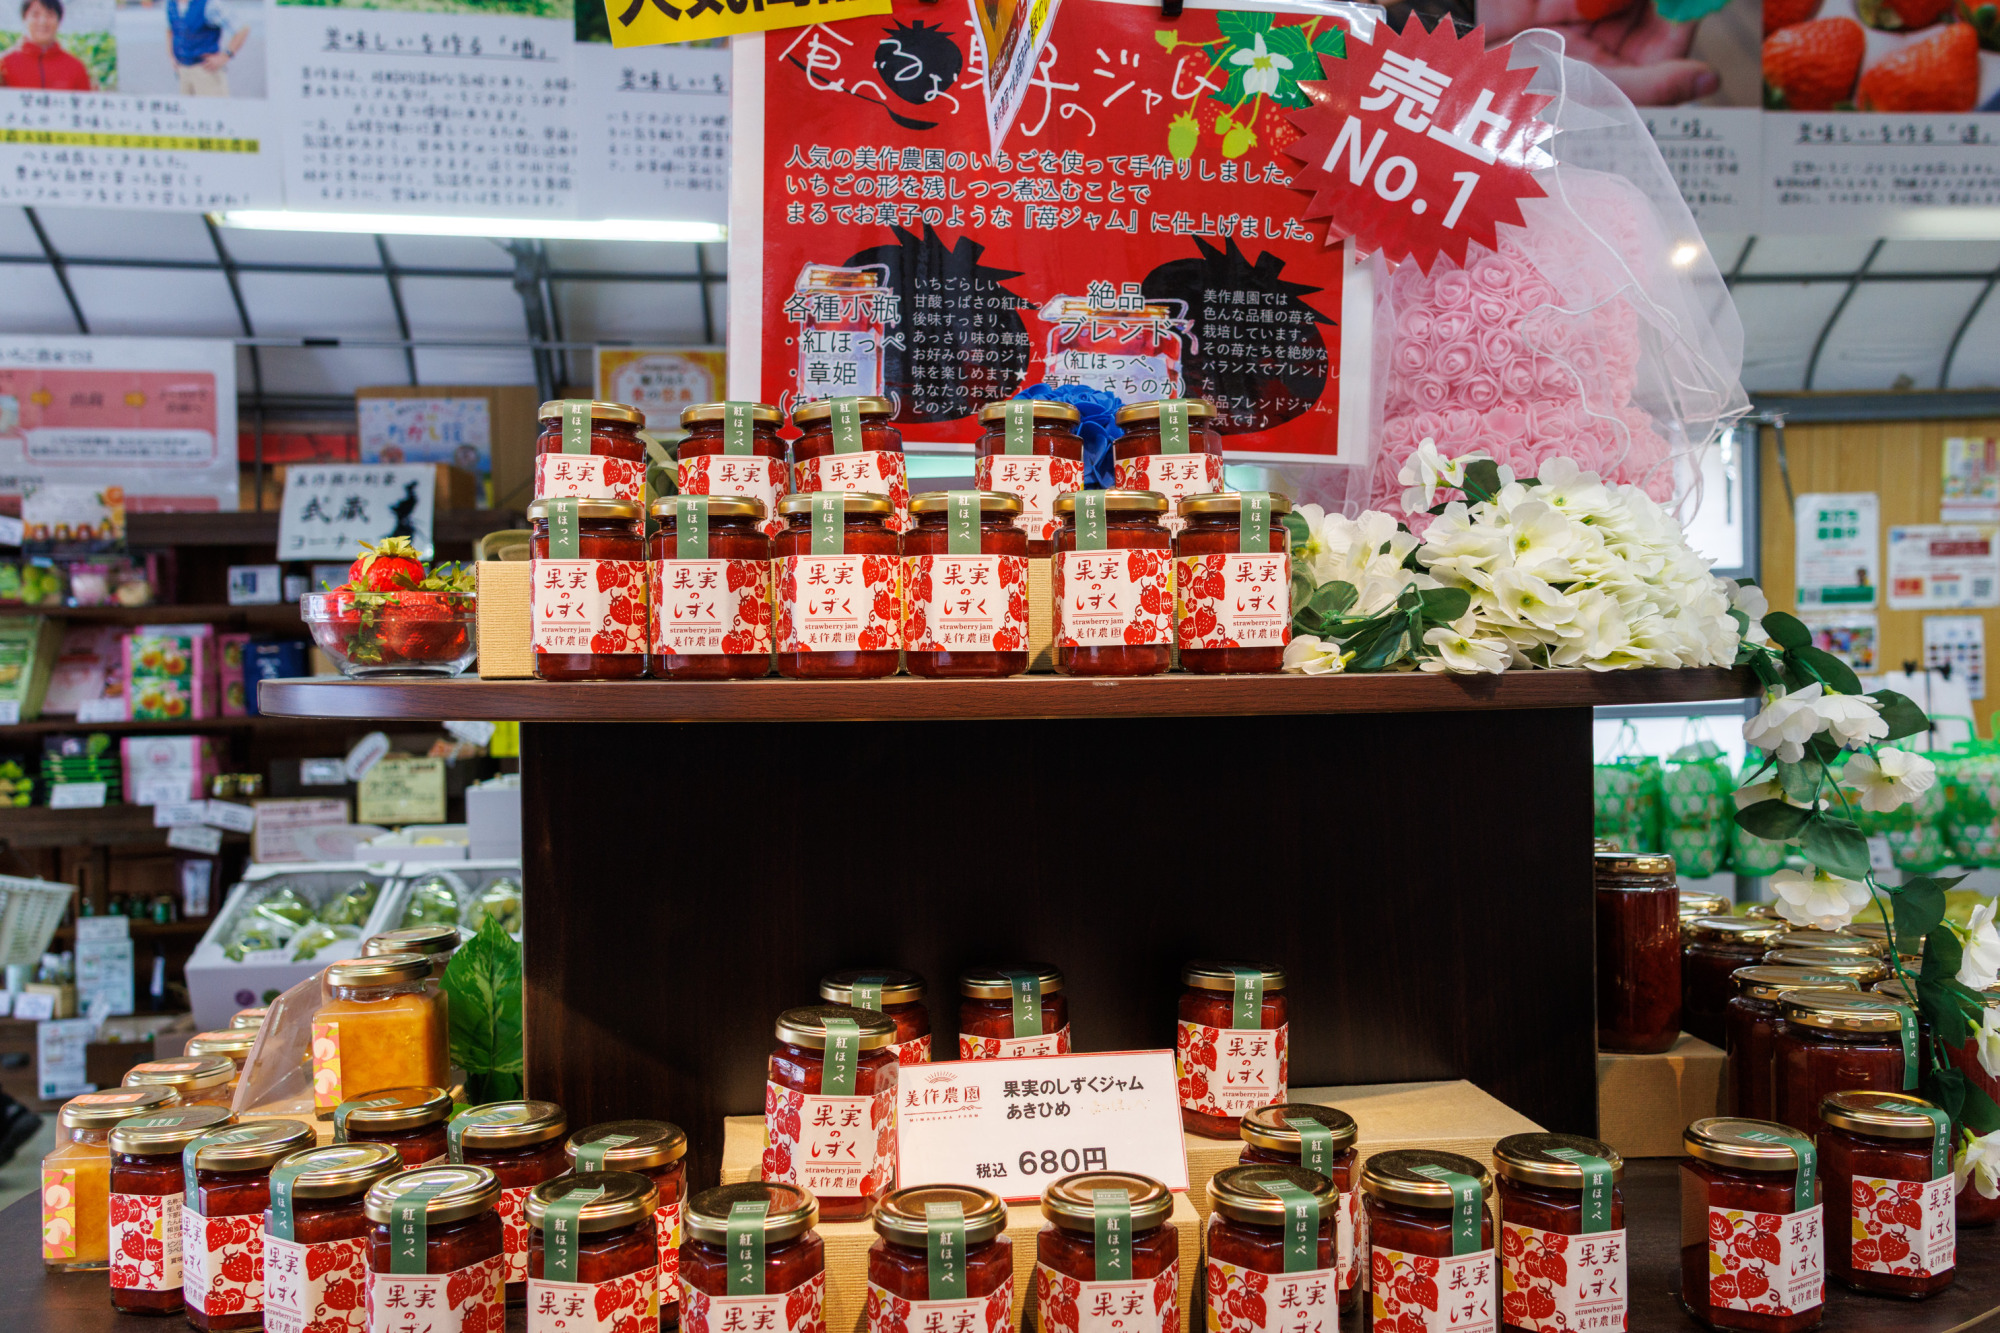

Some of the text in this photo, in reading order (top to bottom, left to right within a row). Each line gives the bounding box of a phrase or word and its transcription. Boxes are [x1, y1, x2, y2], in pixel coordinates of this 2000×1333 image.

[1360, 49, 1512, 166] 売上
[785, 144, 1294, 187] 人気の美作農園のいちごを使って手作りしました。
[1321, 114, 1481, 230] No.1
[786, 174, 1152, 205] いちごの形を残しつつ煮込むことで
[786, 201, 1315, 243] まるでお菓子のような『苺ジャム』に仕上げました。
[914, 277, 1001, 291] いちごらしい
[1087, 280, 1145, 311] 絶品
[1203, 288, 1288, 305] 美作農園では
[783, 293, 901, 323] 各種小瓶
[912, 311, 1006, 329] 後味すっきり、
[1203, 306, 1316, 325] 色んな品種の苺を
[913, 331, 1036, 347] あっさり味の章姫。
[1060, 315, 1171, 346] ブレンド
[1203, 324, 1308, 343] 栽培しています。
[1203, 342, 1328, 360] その苺たちを絶妙な
[1202, 377, 1215, 390] た
[571, 404, 582, 444] 紅ほっぺ
[734, 406, 744, 446] 紅ほっぺ
[840, 402, 854, 442] 紅ほっぺ
[1014, 403, 1025, 444] 紅ほっぺ
[1168, 403, 1180, 443] 紅ほっぺ
[554, 462, 595, 482] 果実
[719, 463, 761, 482] 果実
[829, 459, 870, 481] 果実
[1001, 463, 1042, 482] 果実
[1159, 461, 1199, 481] 果実
[557, 502, 569, 546] 紅ほっぺ
[687, 500, 699, 545] 紅ほっぺ
[823, 499, 835, 544] 紅ほっぺ
[958, 495, 971, 540] 紅ほっぺ
[1085, 494, 1098, 539] 紅ほっぺ
[1250, 497, 1262, 542] 紅ほっぺ
[544, 567, 588, 590] 果実
[673, 567, 718, 590] 果実
[807, 563, 854, 586] 果実
[942, 563, 990, 586] 果実
[1074, 557, 1120, 581] 果実
[1235, 560, 1278, 583] 果実
[545, 602, 586, 619] しずく
[674, 602, 716, 619] しずく
[809, 597, 853, 615] しずく
[944, 598, 988, 616] しずく
[1075, 593, 1118, 611] しずく
[1236, 595, 1277, 612] しずく
[541, 626, 591, 635] strawberry jam
[670, 626, 722, 636] strawberry jam
[805, 622, 859, 631] strawberry jam
[939, 623, 994, 632] strawberry jam
[1072, 617, 1124, 626] strawberry jam
[1232, 619, 1282, 627] strawberry jam
[1021, 981, 1034, 1021] 紅ほっぺ
[1243, 979, 1255, 1019] 紅ほっぺ
[1226, 1036, 1268, 1057] 果実
[832, 1036, 848, 1083] 紅ほっぺ
[1003, 1075, 1145, 1099] 果実のしずくジャム
[1226, 1068, 1265, 1084] しずく
[904, 1085, 981, 1108] 美作農園
[812, 1104, 862, 1128] 果実
[1006, 1101, 1071, 1121] あきひめ
[811, 1140, 857, 1159] しずく
[805, 1167, 862, 1175] strawberry jam
[976, 1147, 1108, 1179] 税込 680円
[276, 1181, 288, 1230] 紅ほっぺ
[1591, 1173, 1603, 1221] 紅ほっぺ
[1929, 1184, 1952, 1210] 果実
[1462, 1189, 1474, 1237] 紅ほっぺ
[402, 1207, 416, 1258] 紅ほっぺ
[1106, 1217, 1121, 1268] 紅ほっぺ
[1295, 1205, 1309, 1255] 紅ほっぺ
[1789, 1216, 1818, 1246] 果実
[554, 1218, 568, 1269] 紅ほっぺ
[1578, 1240, 1620, 1267] 果実
[267, 1247, 300, 1276] 果実
[739, 1233, 753, 1284] 紅ほっぺ
[939, 1231, 955, 1283] 紅ほっぺ
[1791, 1251, 1817, 1277] しずく
[1448, 1260, 1490, 1290] 果実
[268, 1282, 298, 1307] しずく
[385, 1284, 437, 1308] 果実
[1278, 1280, 1327, 1308] 果実
[1579, 1277, 1618, 1300] しずく
[537, 1291, 585, 1318] 果実
[1090, 1289, 1144, 1317] 果実
[1450, 1299, 1489, 1324] しずく
[1574, 1303, 1624, 1316] strawberry jam
[721, 1305, 776, 1332] 果実
